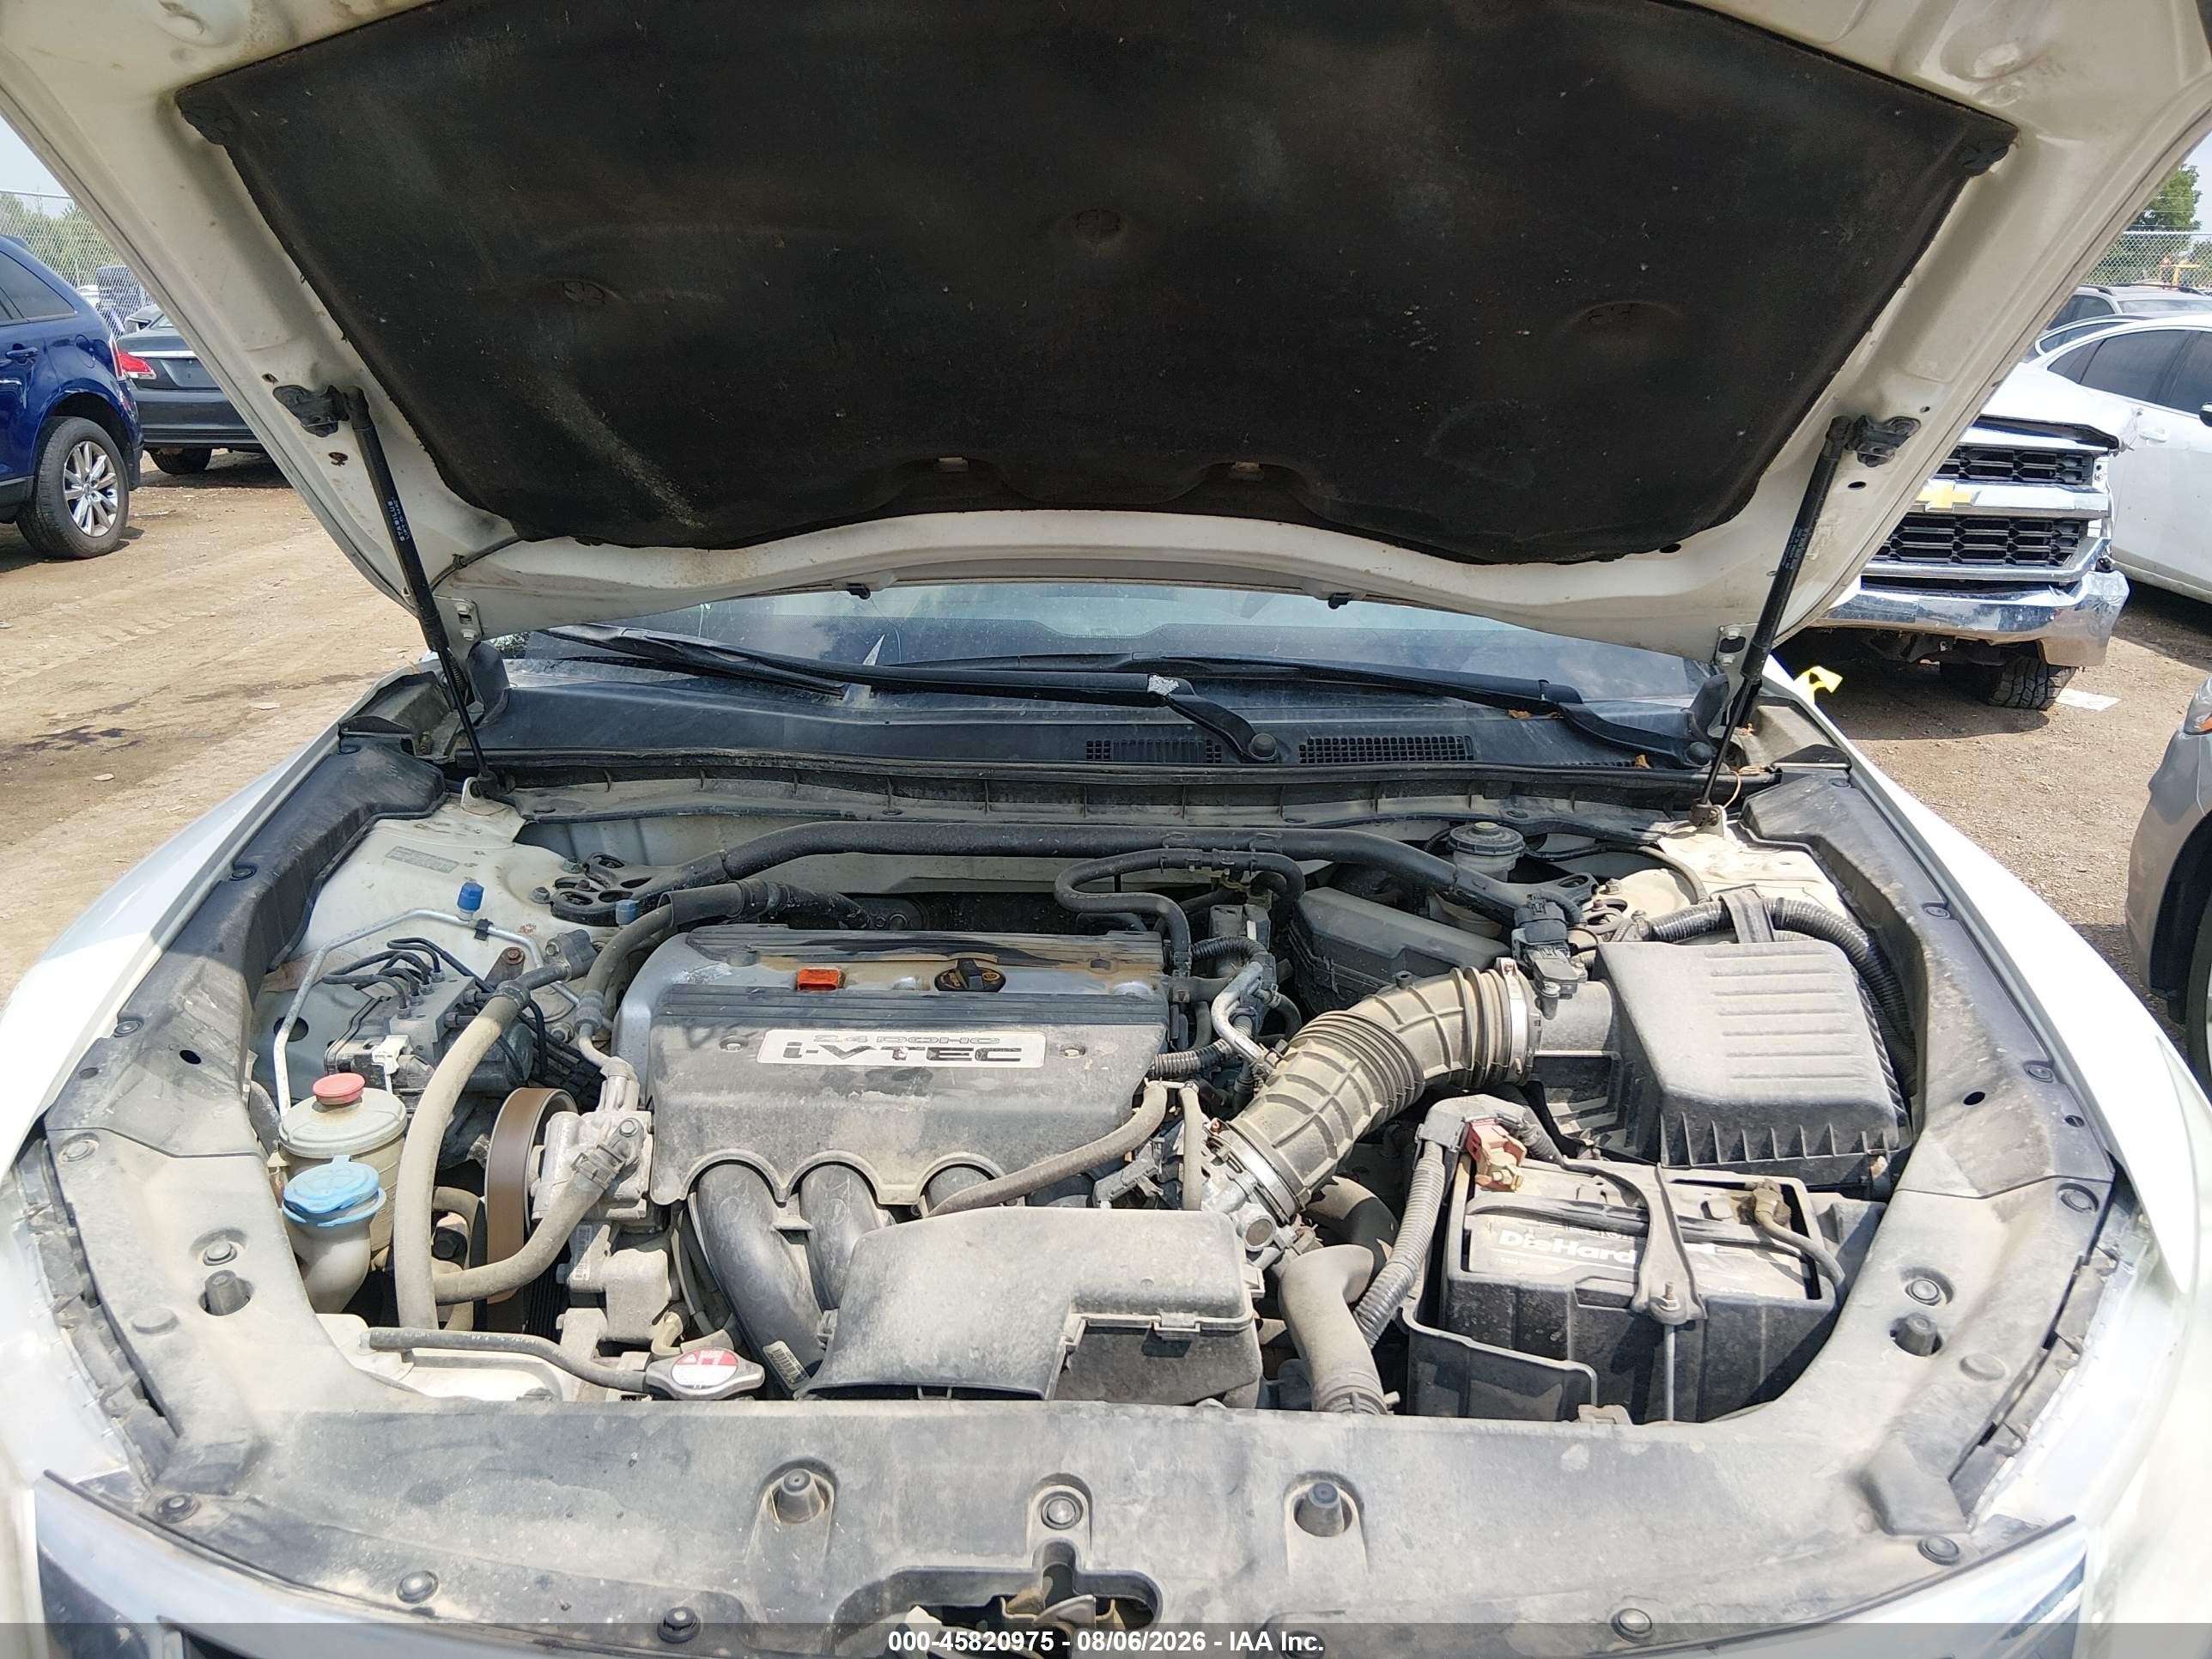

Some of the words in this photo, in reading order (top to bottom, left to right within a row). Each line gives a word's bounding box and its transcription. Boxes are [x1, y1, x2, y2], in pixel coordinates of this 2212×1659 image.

[876, 1035, 1000, 1044] DOHC
[782, 1041, 1022, 1061] i-VTEC
[1498, 1228, 1638, 1265] DieHard
